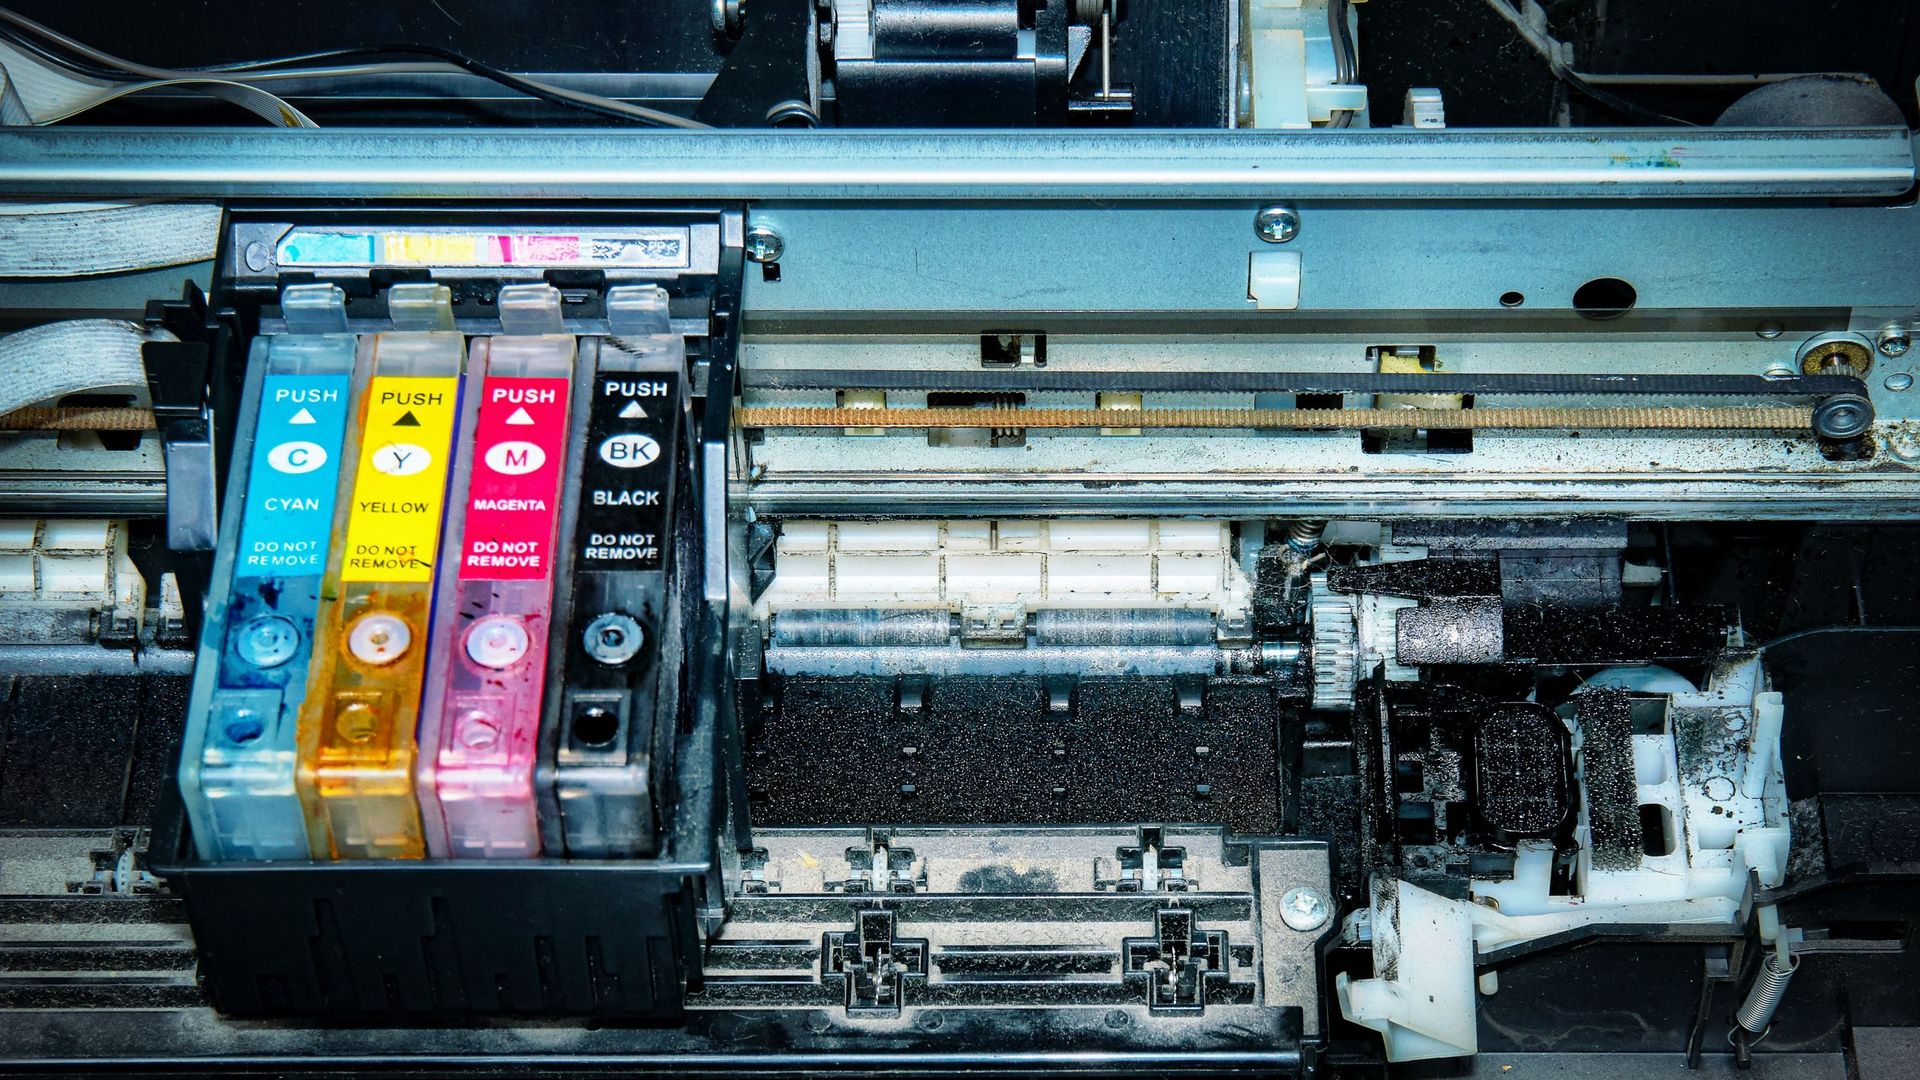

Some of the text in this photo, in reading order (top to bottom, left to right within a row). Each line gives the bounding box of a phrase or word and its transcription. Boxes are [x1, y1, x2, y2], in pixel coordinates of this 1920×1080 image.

[276, 389, 338, 402] PUSH
[605, 382, 667, 397] PUSH
[381, 392, 443, 405] PUSH
[492, 389, 555, 403] PUSH
[610, 441, 652, 460] BK
[288, 449, 308, 466] C
[393, 452, 411, 469] Y
[505, 449, 528, 467] M
[593, 491, 659, 505] BLACK
[265, 498, 319, 511] CYAN
[360, 502, 429, 513] YELLOW
[474, 499, 546, 511] MAGENTA
[591, 534, 655, 545] DO NOT
[254, 541, 317, 552] DO NOT
[356, 545, 418, 555] DO NOT
[473, 542, 538, 553] DO NOT
[248, 554, 318, 565] REMOVE
[585, 548, 658, 560] REMOVE
[350, 559, 418, 569] REMOVE
[467, 556, 540, 567] REMOVE
